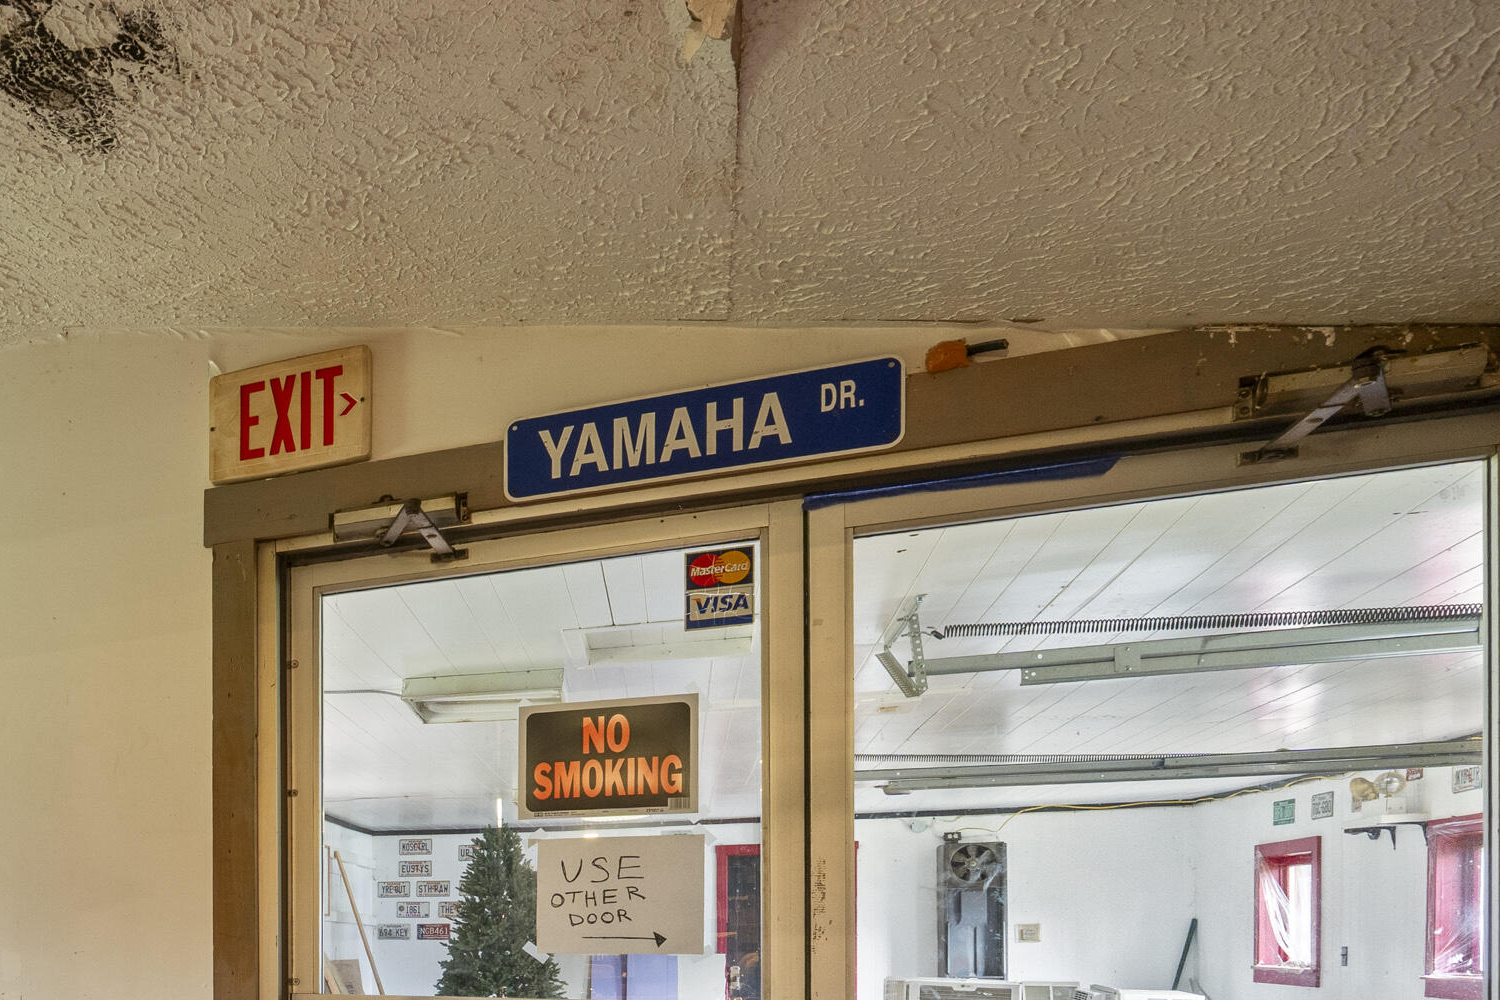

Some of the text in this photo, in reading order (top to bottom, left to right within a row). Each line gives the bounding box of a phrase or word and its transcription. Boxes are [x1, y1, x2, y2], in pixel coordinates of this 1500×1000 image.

[240, 365, 343, 461] EXIT
[538, 380, 865, 479] YAMAHA DR.
[691, 561, 749, 577] MasterCard
[692, 594, 749, 614] VISA
[582, 713, 630, 755] NO
[533, 754, 683, 800] SMOKING
[561, 855, 644, 883] USE
[550, 886, 646, 908] OTHER
[569, 909, 632, 927] DOOR
